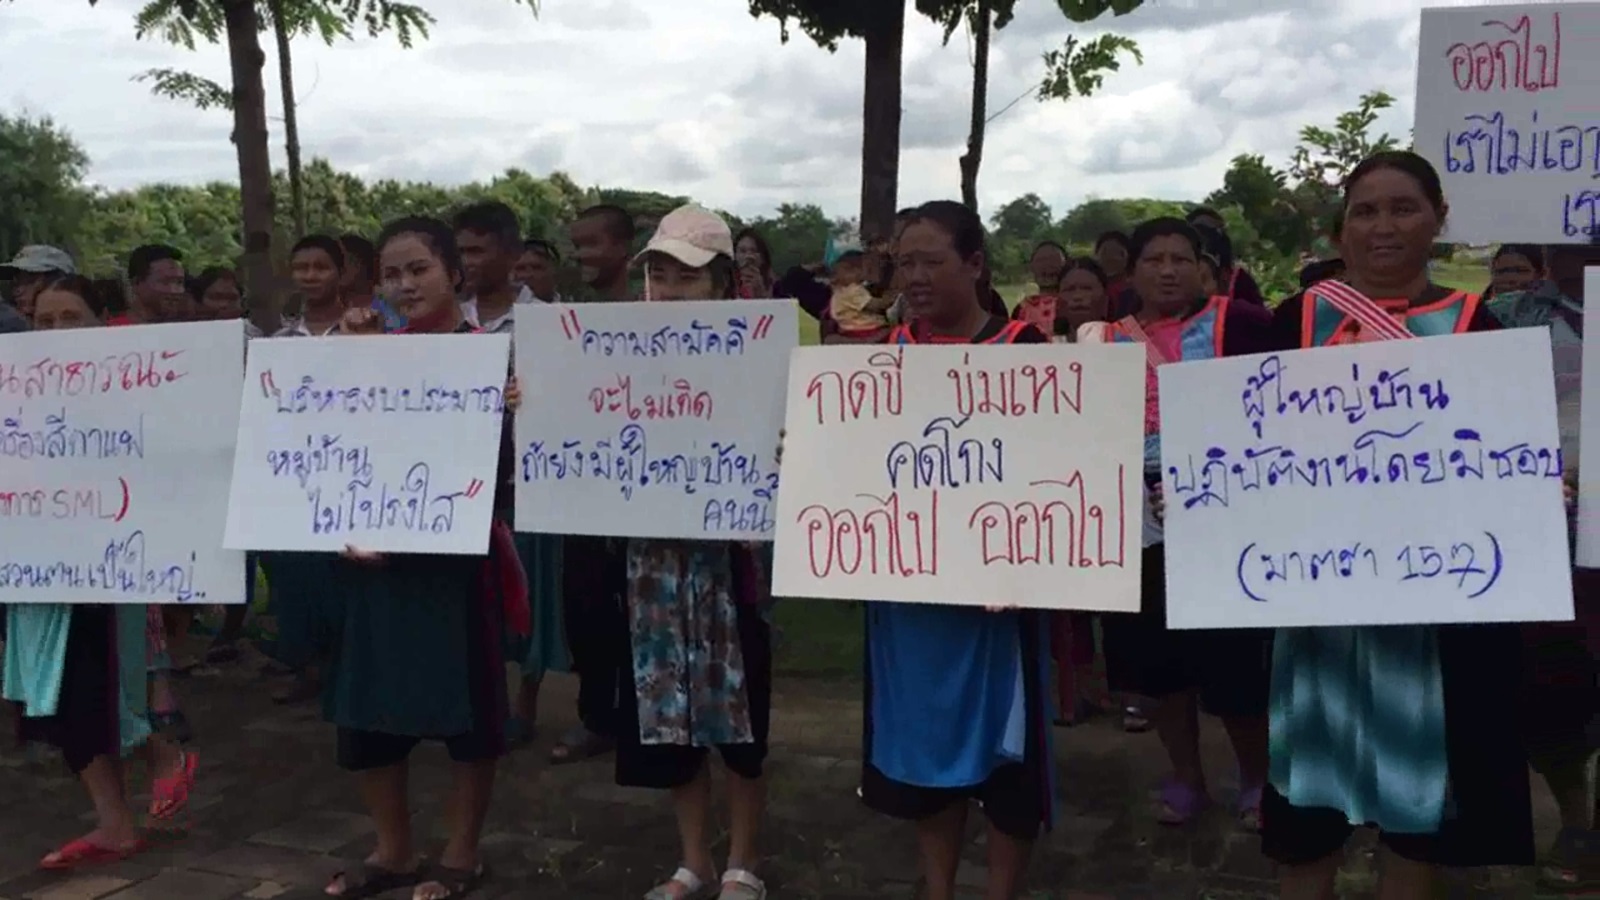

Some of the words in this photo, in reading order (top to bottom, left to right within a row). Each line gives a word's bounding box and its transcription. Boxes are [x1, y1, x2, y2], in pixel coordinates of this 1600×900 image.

[1446, 13, 1560, 91] ออกไป
[947, 352, 1083, 417] ข่มเหง
[1242, 355, 1450, 438] ผู้ใหญ่บ้าน
[887, 416, 1004, 489] คดโกง
[703, 472, 780, 533] คนนี้
[797, 489, 938, 578] ออกไป
[968, 463, 1125, 569] ออกไป
